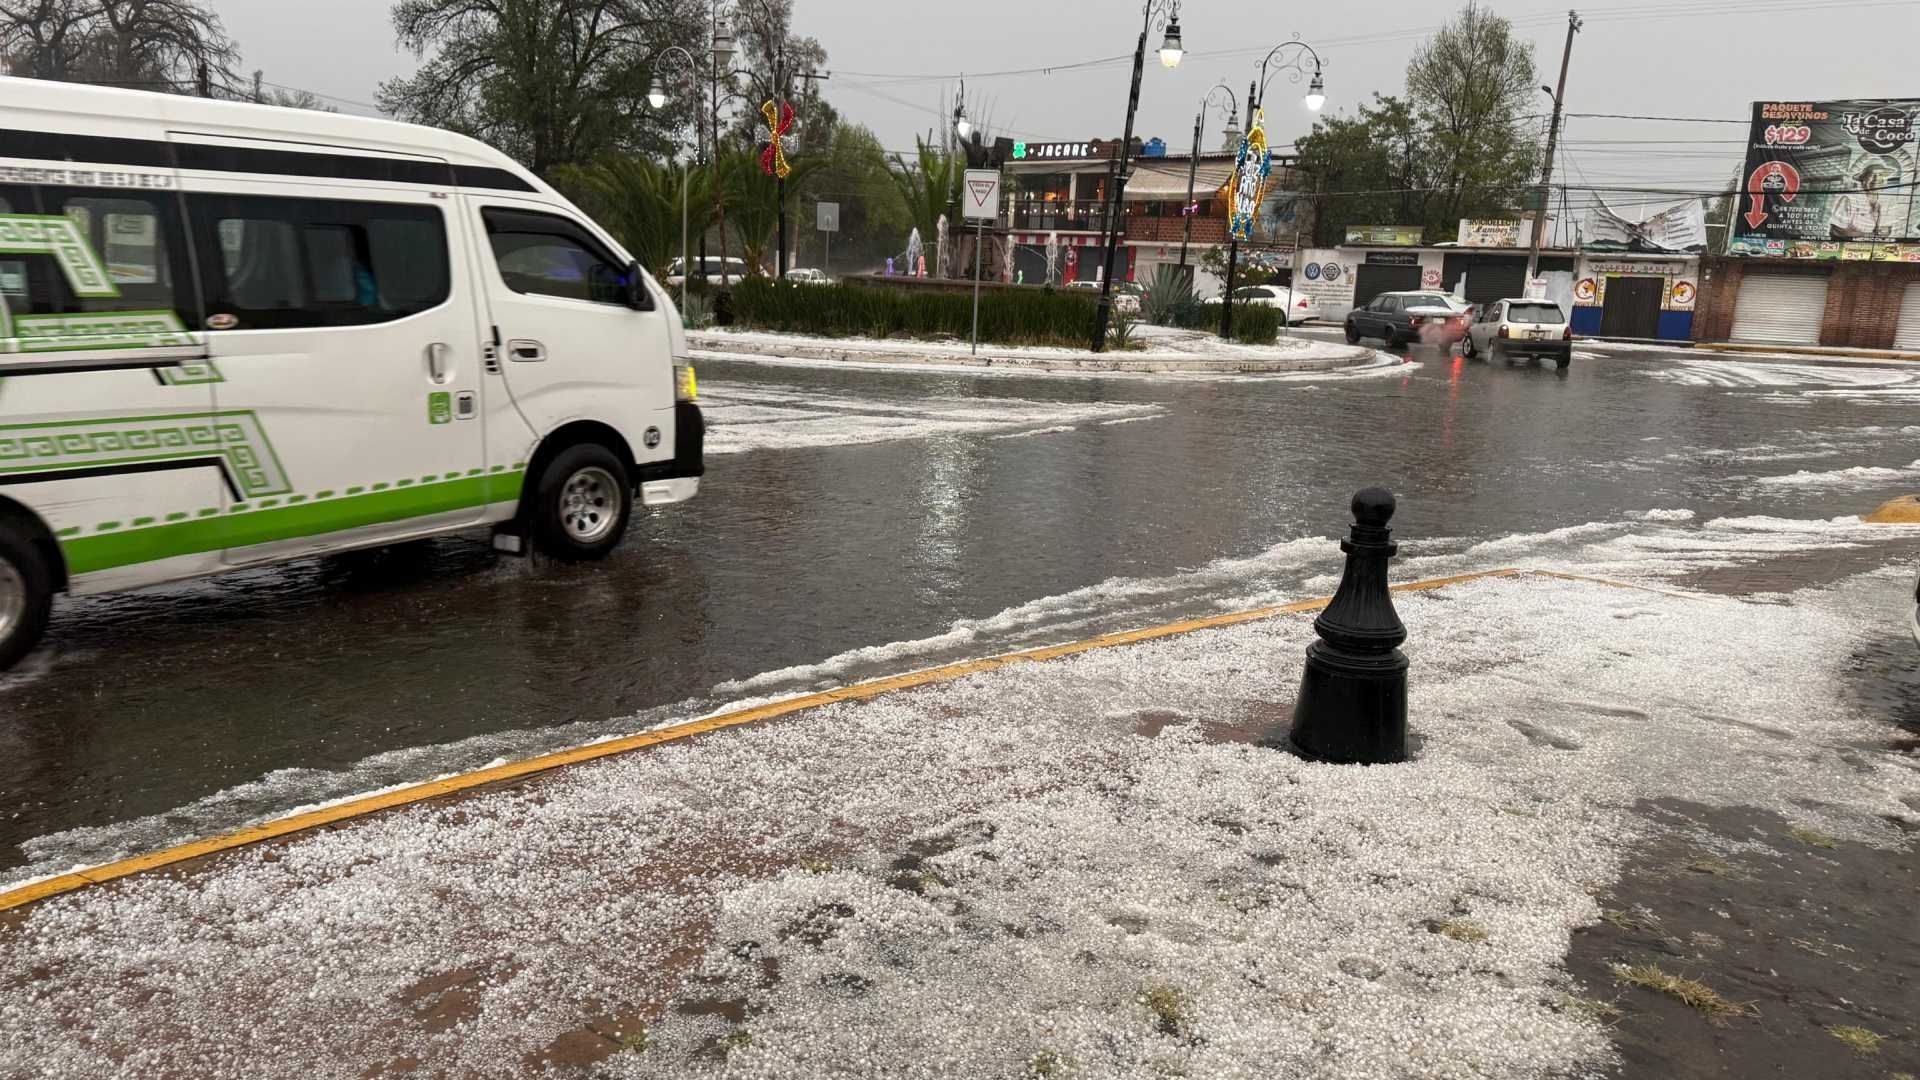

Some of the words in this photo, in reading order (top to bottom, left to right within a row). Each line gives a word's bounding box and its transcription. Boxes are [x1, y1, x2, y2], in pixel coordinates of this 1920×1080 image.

[1762, 103, 1813, 112] PAQUETE
[1761, 111, 1829, 120] DESAYUNOS
[1863, 114, 1905, 128] Casa
[1765, 125, 1811, 144] $129
[1875, 129, 1914, 141] Coco
